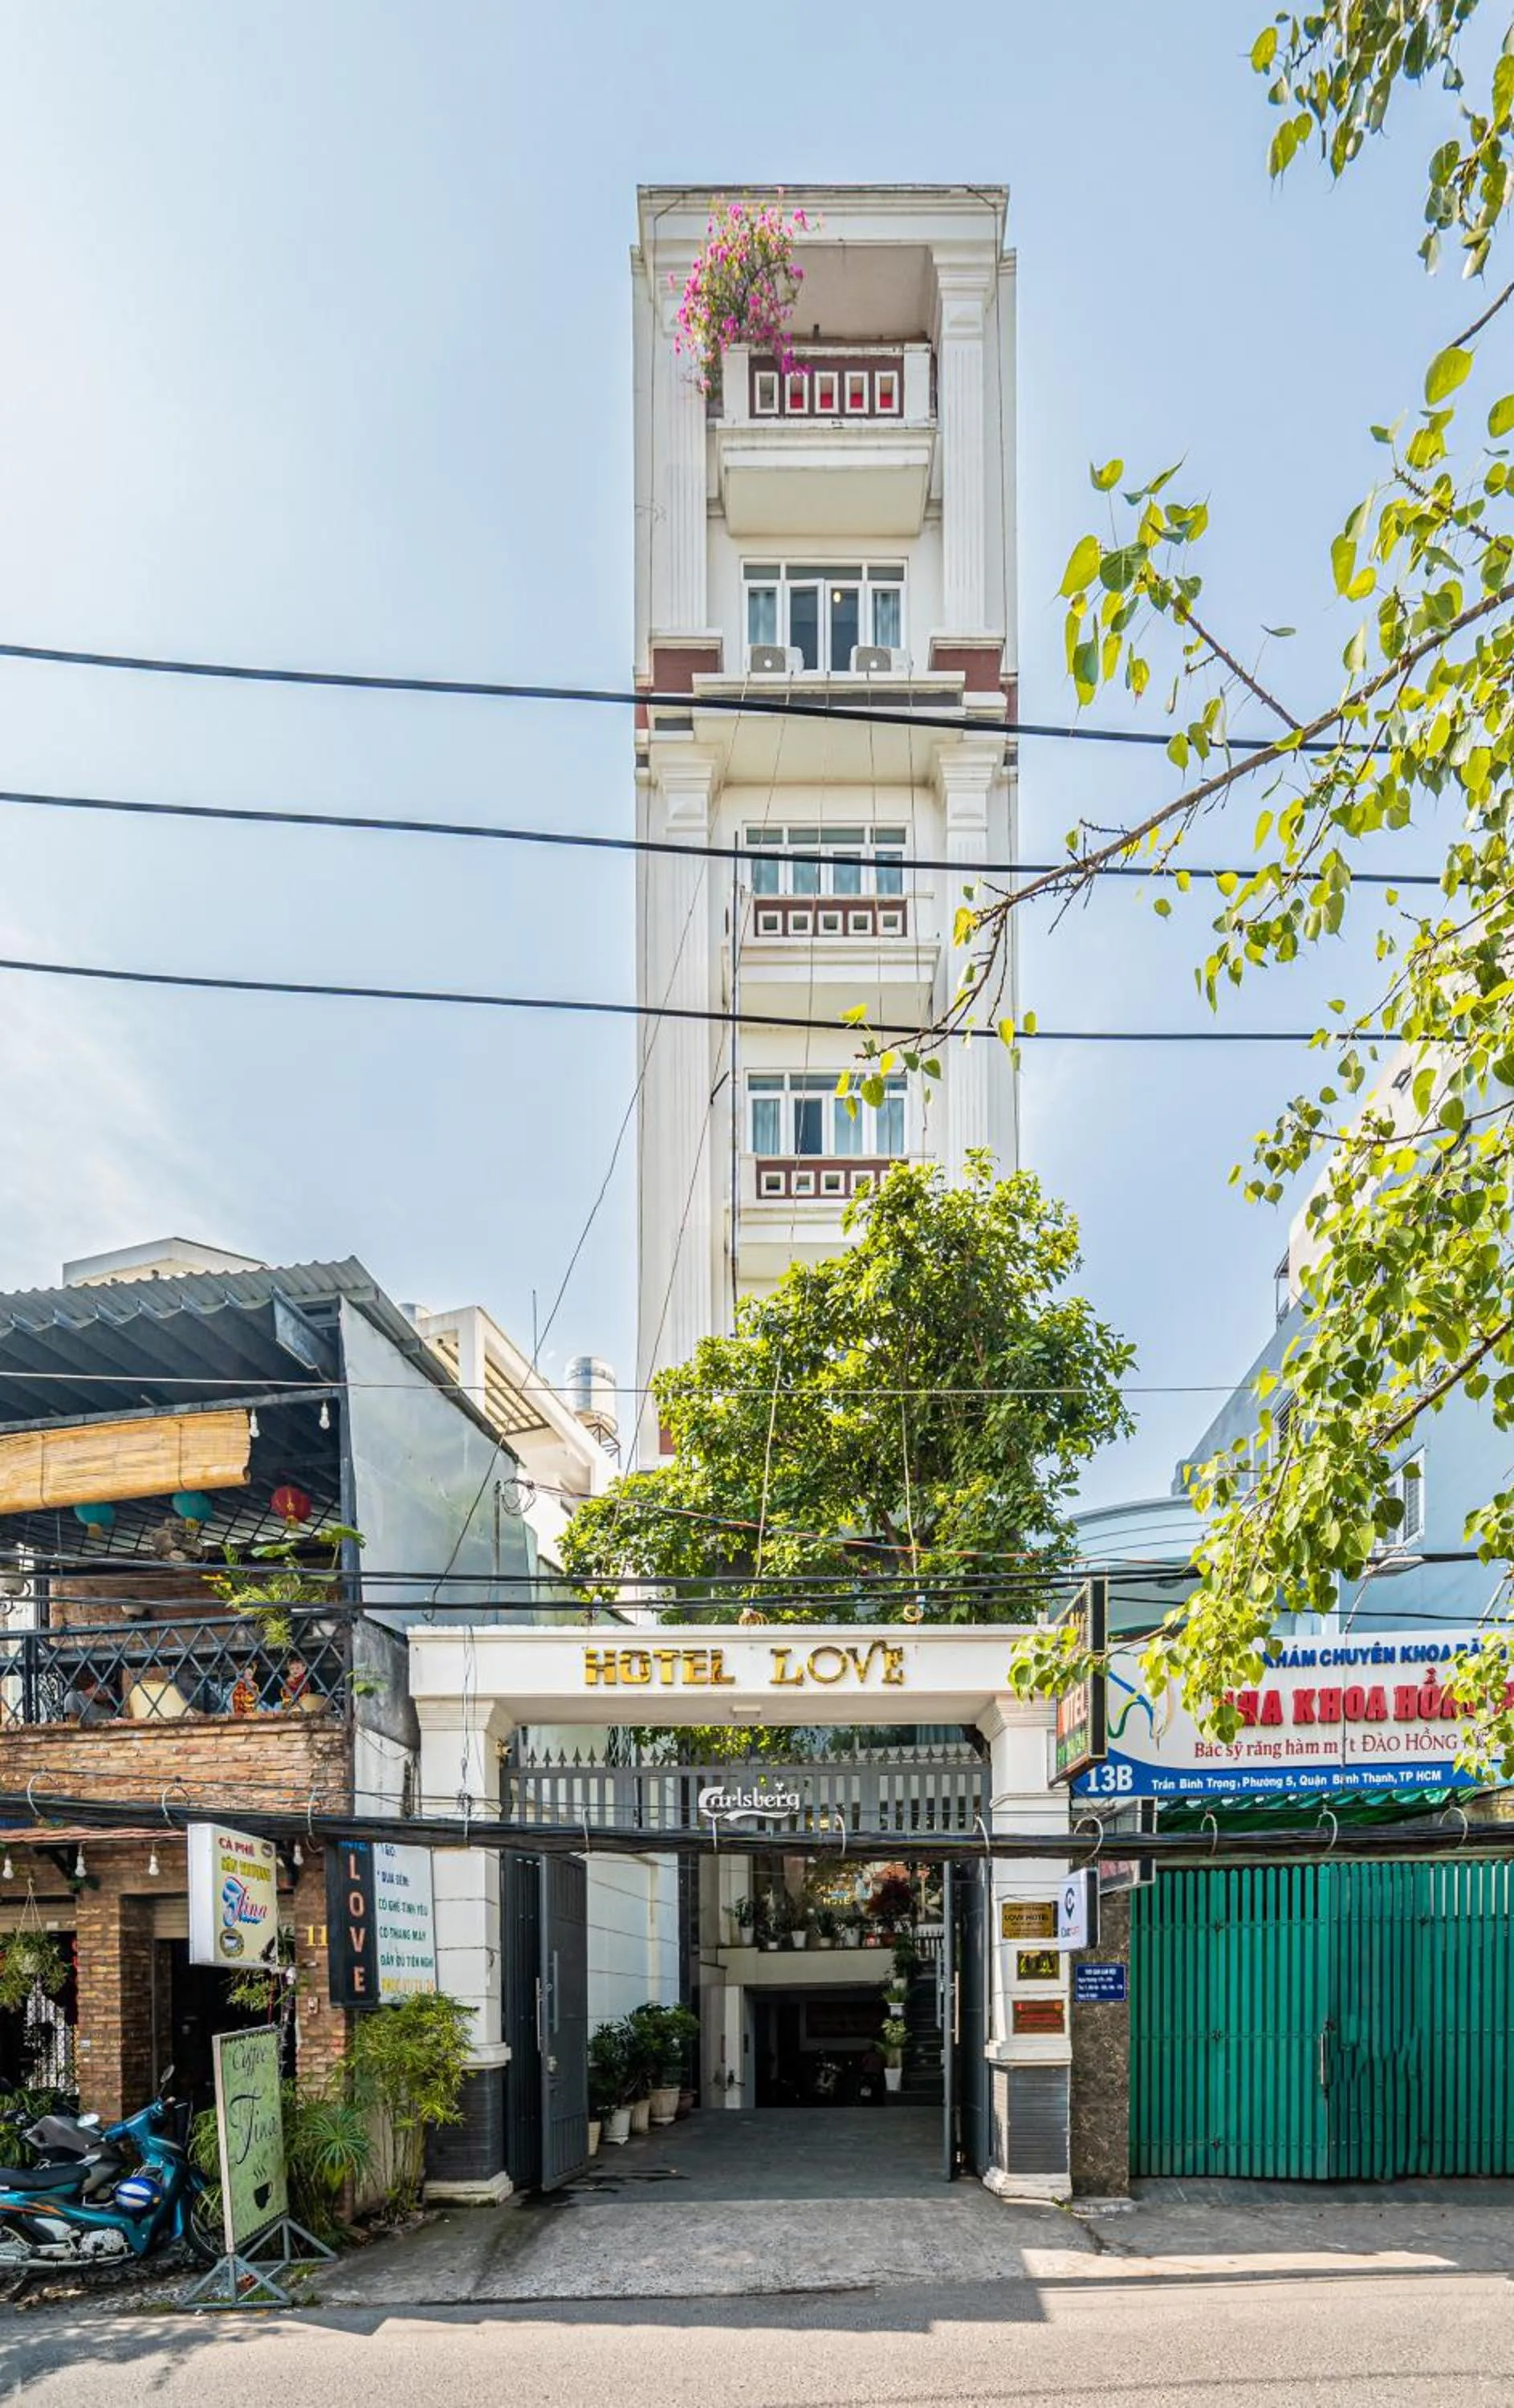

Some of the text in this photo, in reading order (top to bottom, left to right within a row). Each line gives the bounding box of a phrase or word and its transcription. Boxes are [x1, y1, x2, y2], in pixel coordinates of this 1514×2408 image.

[584, 1640, 904, 1685] HOTEL LOVE
[1319, 1641, 1396, 1667] CHUYÊN
[1400, 1643, 1451, 1662] KHOA
[1292, 1685, 1389, 1724] KHOA
[1247, 1740, 1282, 1759] răng
[1285, 1738, 1319, 1755] hàm
[1361, 1731, 1400, 1752] ĐÀO
[1405, 1727, 1458, 1751] HỒNG
[1087, 1765, 1133, 1792] 13B
[1398, 1771, 1414, 1782] TP
[1416, 1770, 1442, 1781] HCM
[698, 1786, 800, 1820] Carlsberg
[348, 1853, 365, 1991] LOVE
